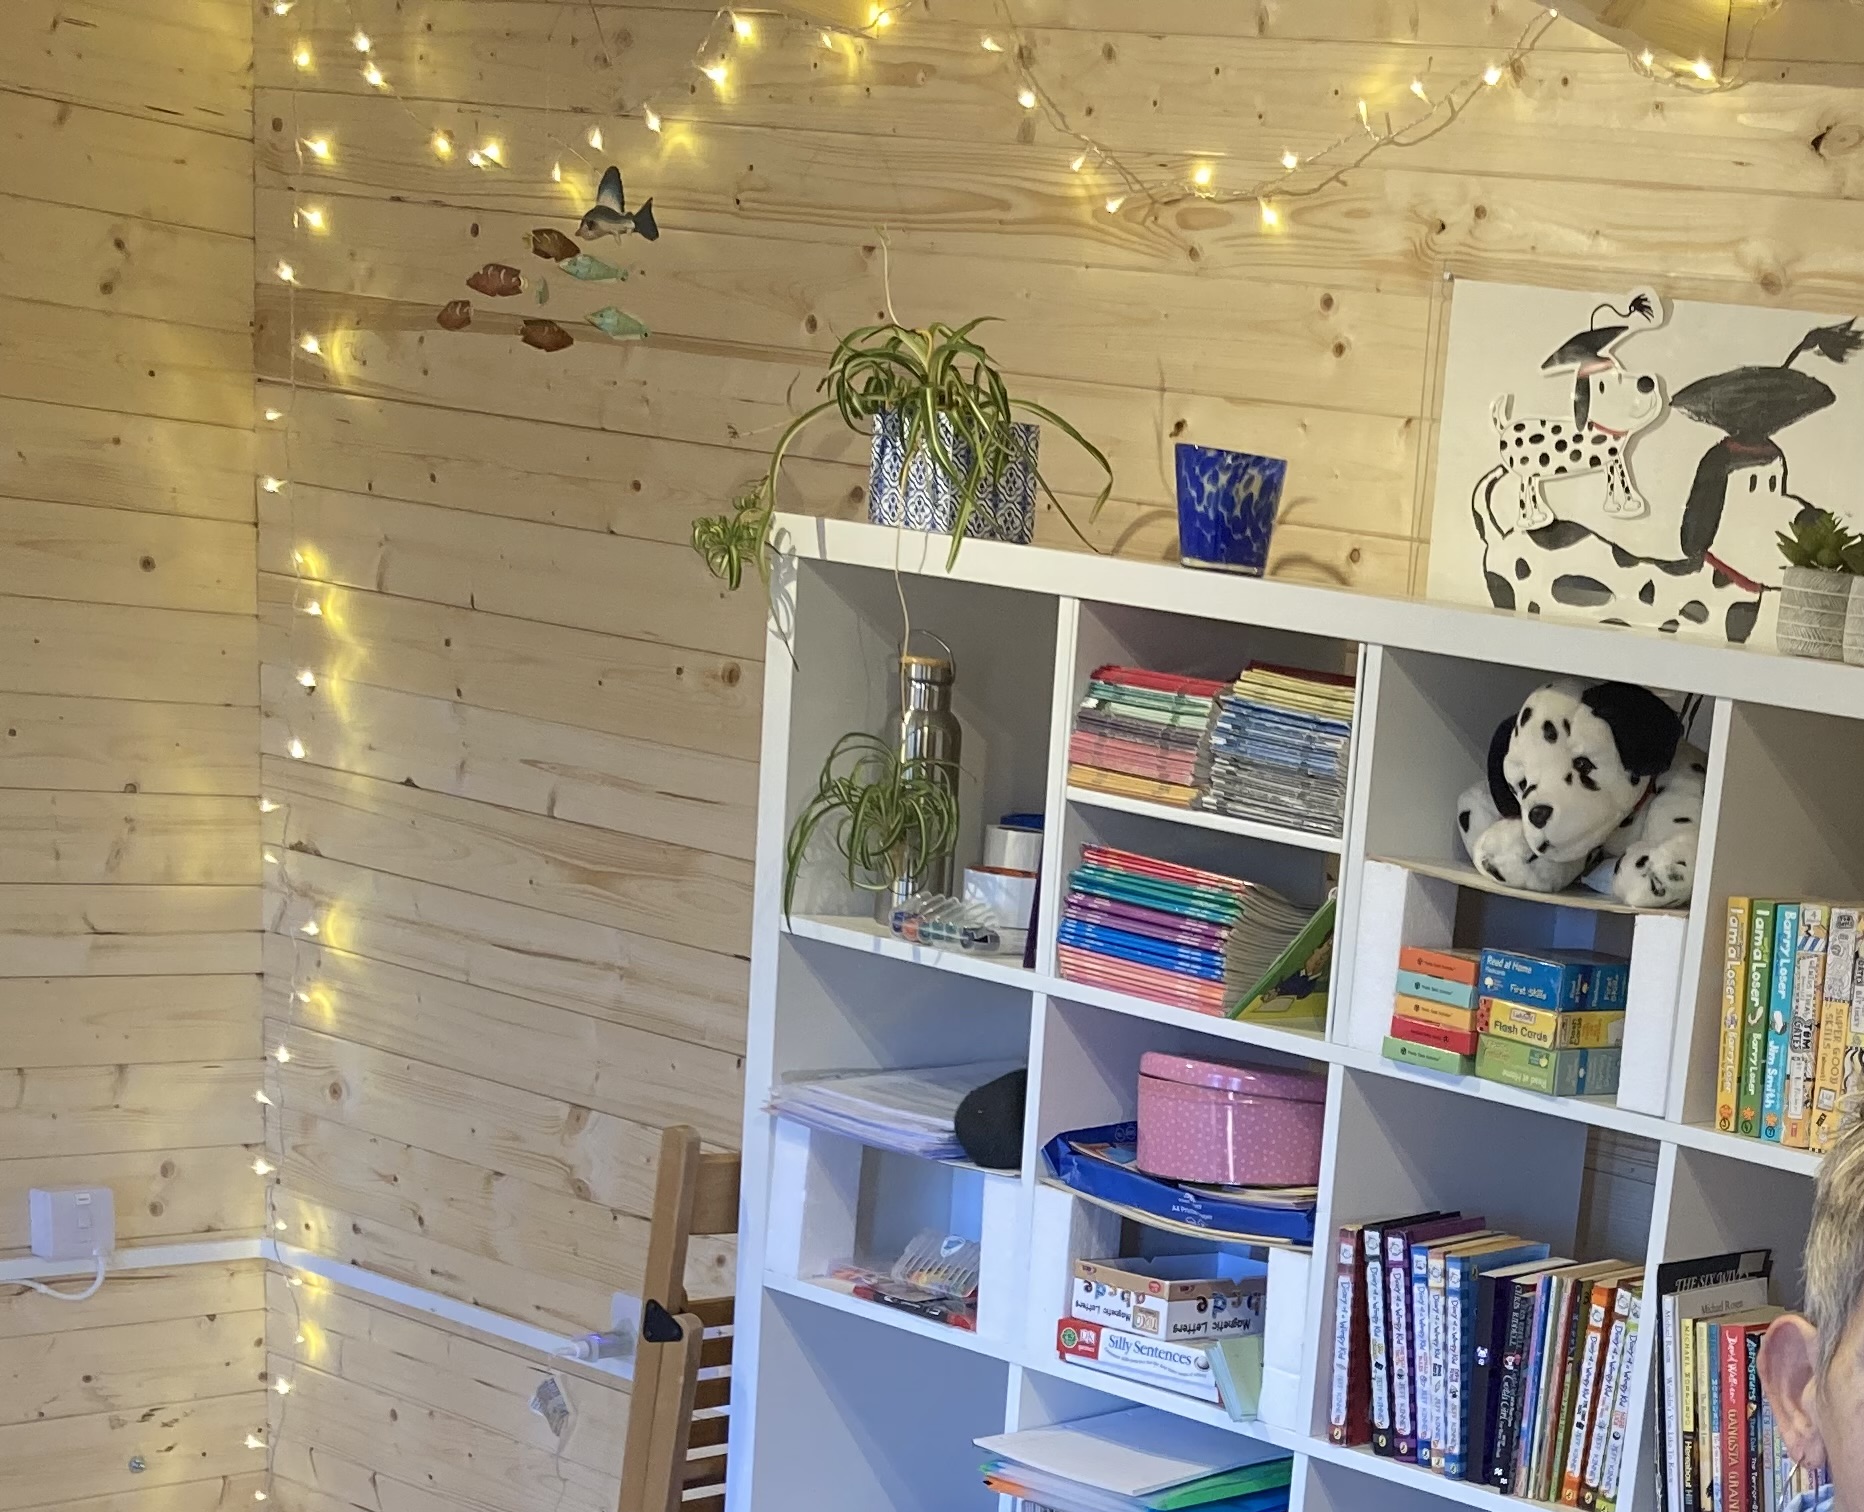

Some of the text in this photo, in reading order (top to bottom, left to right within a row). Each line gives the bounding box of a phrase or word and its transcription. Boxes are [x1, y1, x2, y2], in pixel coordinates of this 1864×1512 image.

[1486, 955, 1532, 974] Read at Home
[1778, 911, 1797, 1000] Barry Loser
[1510, 983, 1526, 994] First
[1725, 961, 1740, 1007] Loser
[1750, 962, 1767, 1008] Loser
[1494, 1020, 1548, 1042] Flash Cards
[1822, 1012, 1833, 1049] SKILLS
[1829, 1008, 1843, 1085] SUPER GOOD
[1765, 1069, 1778, 1109] Smith
[1076, 1300, 1100, 1315] Letters
[1103, 1308, 1131, 1322] Magnetic
[1702, 1303, 1723, 1314] Michael
[1173, 1320, 1208, 1334] Letters
[1212, 1318, 1251, 1332] Magnetic
[1109, 1335, 1132, 1351] Silly
[1133, 1343, 1192, 1366] Sentences
[1724, 1329, 1738, 1362] David
[1745, 1337, 1758, 1401] Astrosaurs
[1725, 1408, 1739, 1467] GANGSTA
[1683, 1440, 1694, 1505] Hereabout Hill
